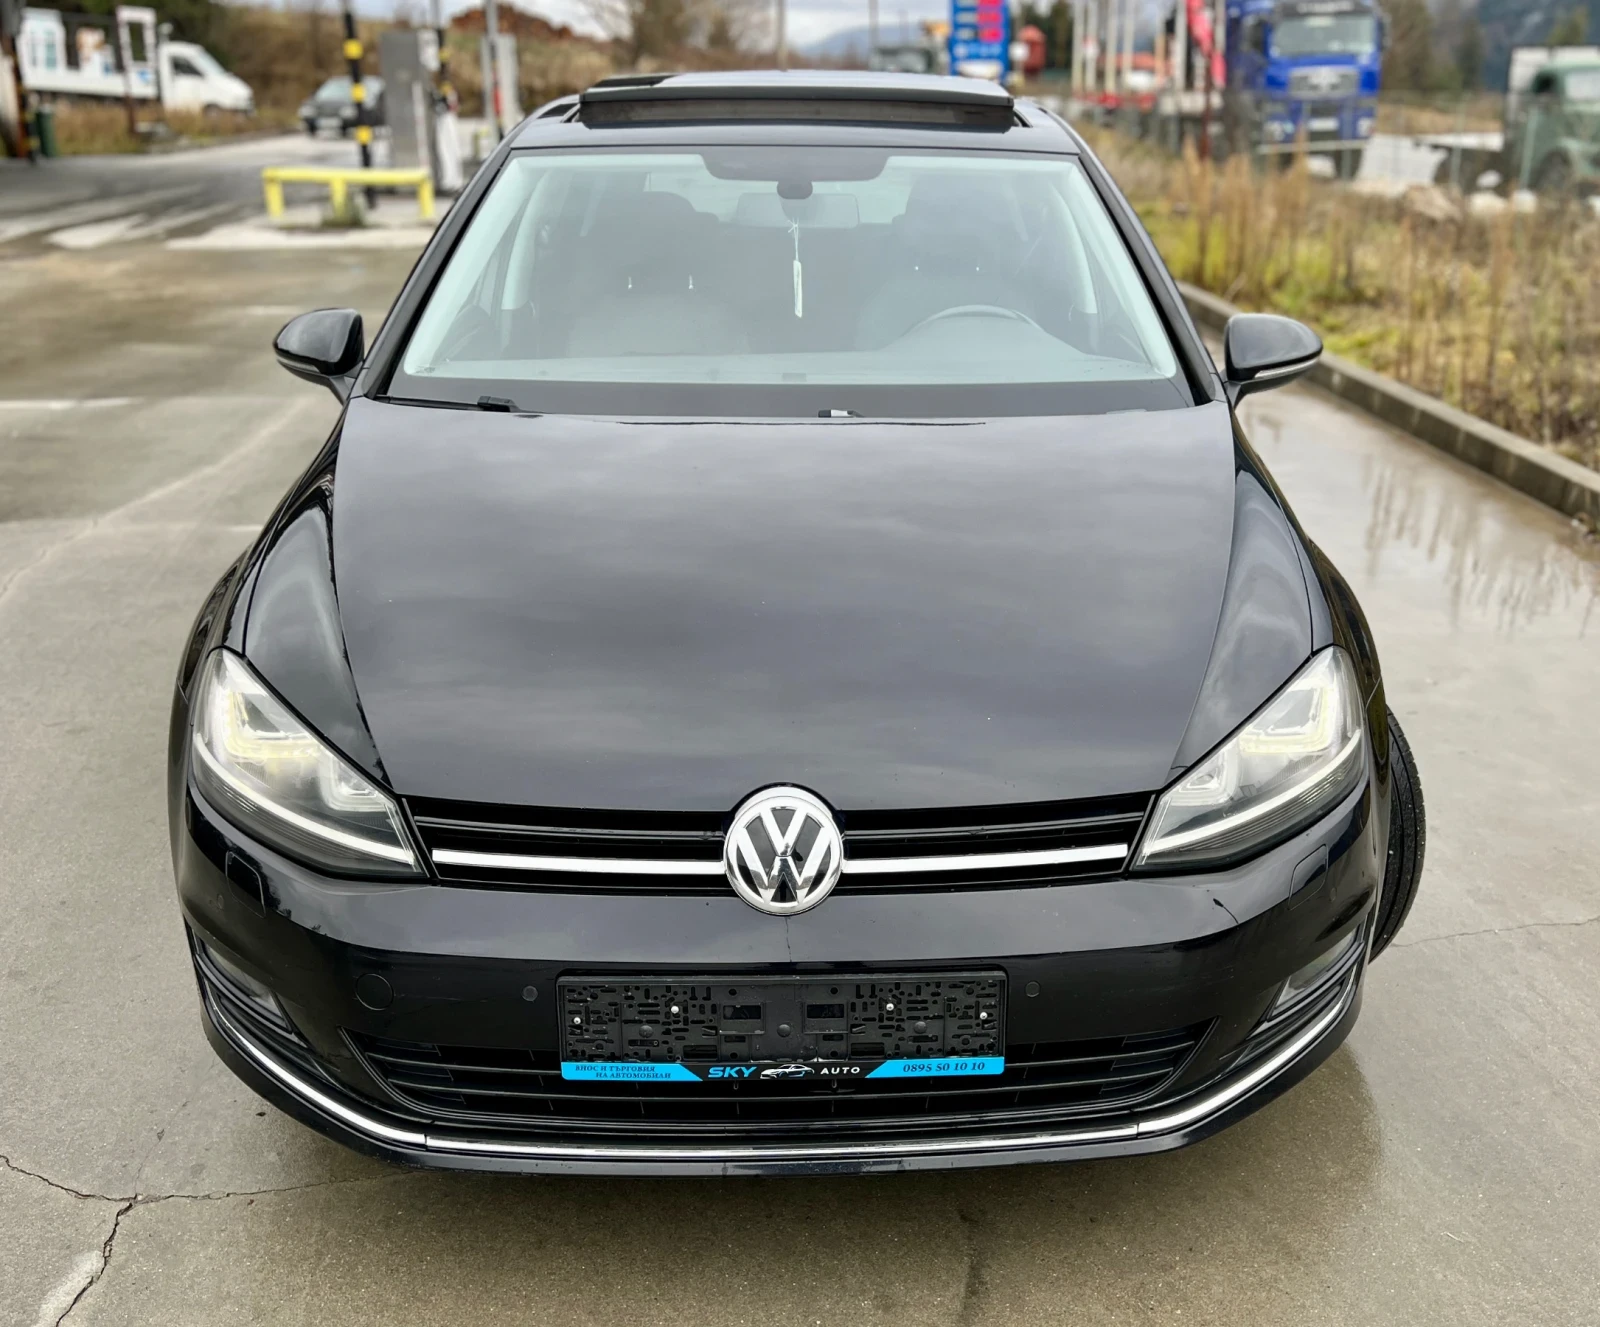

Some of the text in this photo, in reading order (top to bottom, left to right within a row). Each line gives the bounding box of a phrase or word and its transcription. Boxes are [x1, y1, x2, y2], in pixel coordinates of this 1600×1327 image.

[575, 1064, 599, 1072] ВНОС
[707, 1066, 861, 1078] SKY AUTO
[903, 1061, 985, 1073] 0895 50 10 10
